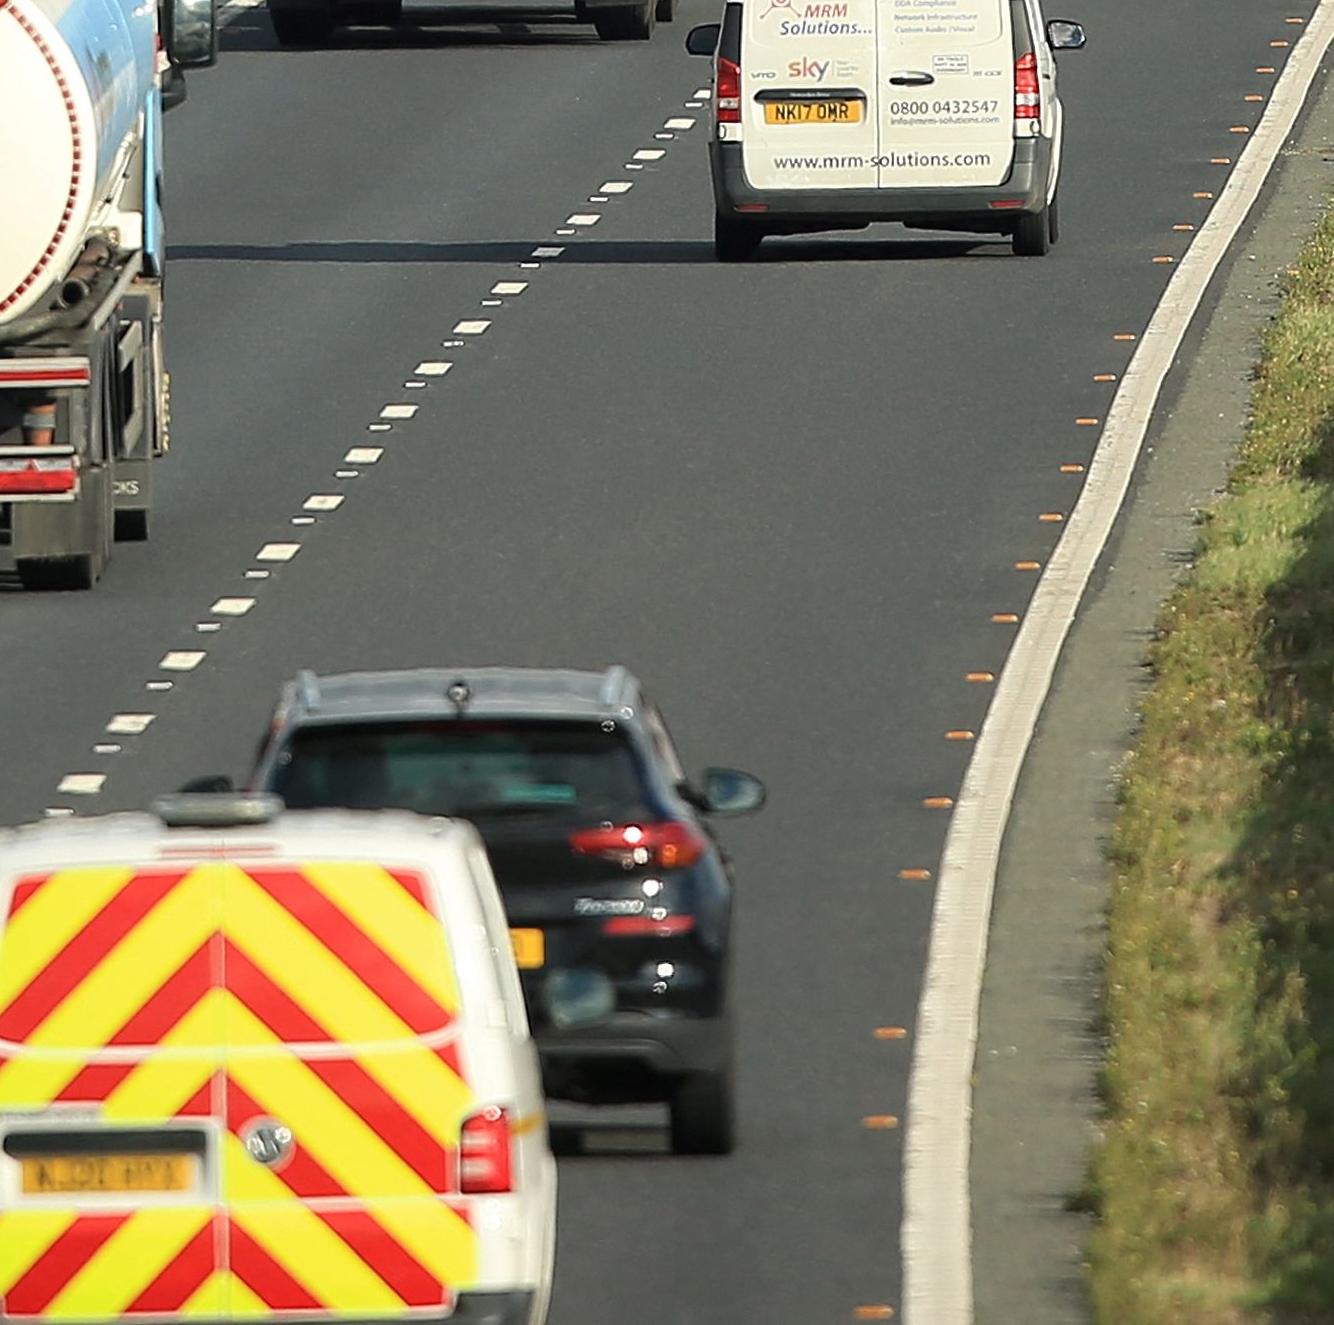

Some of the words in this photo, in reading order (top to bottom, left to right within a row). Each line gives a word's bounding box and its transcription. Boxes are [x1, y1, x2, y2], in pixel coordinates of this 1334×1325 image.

[803, 2, 849, 19] MRM
[788, 56, 831, 83] sky
[775, 103, 814, 121] NK17
[890, 100, 930, 115] 0800
[932, 99, 999, 115] 0432547
[773, 151, 992, 170] www.mrm-solutions.com
